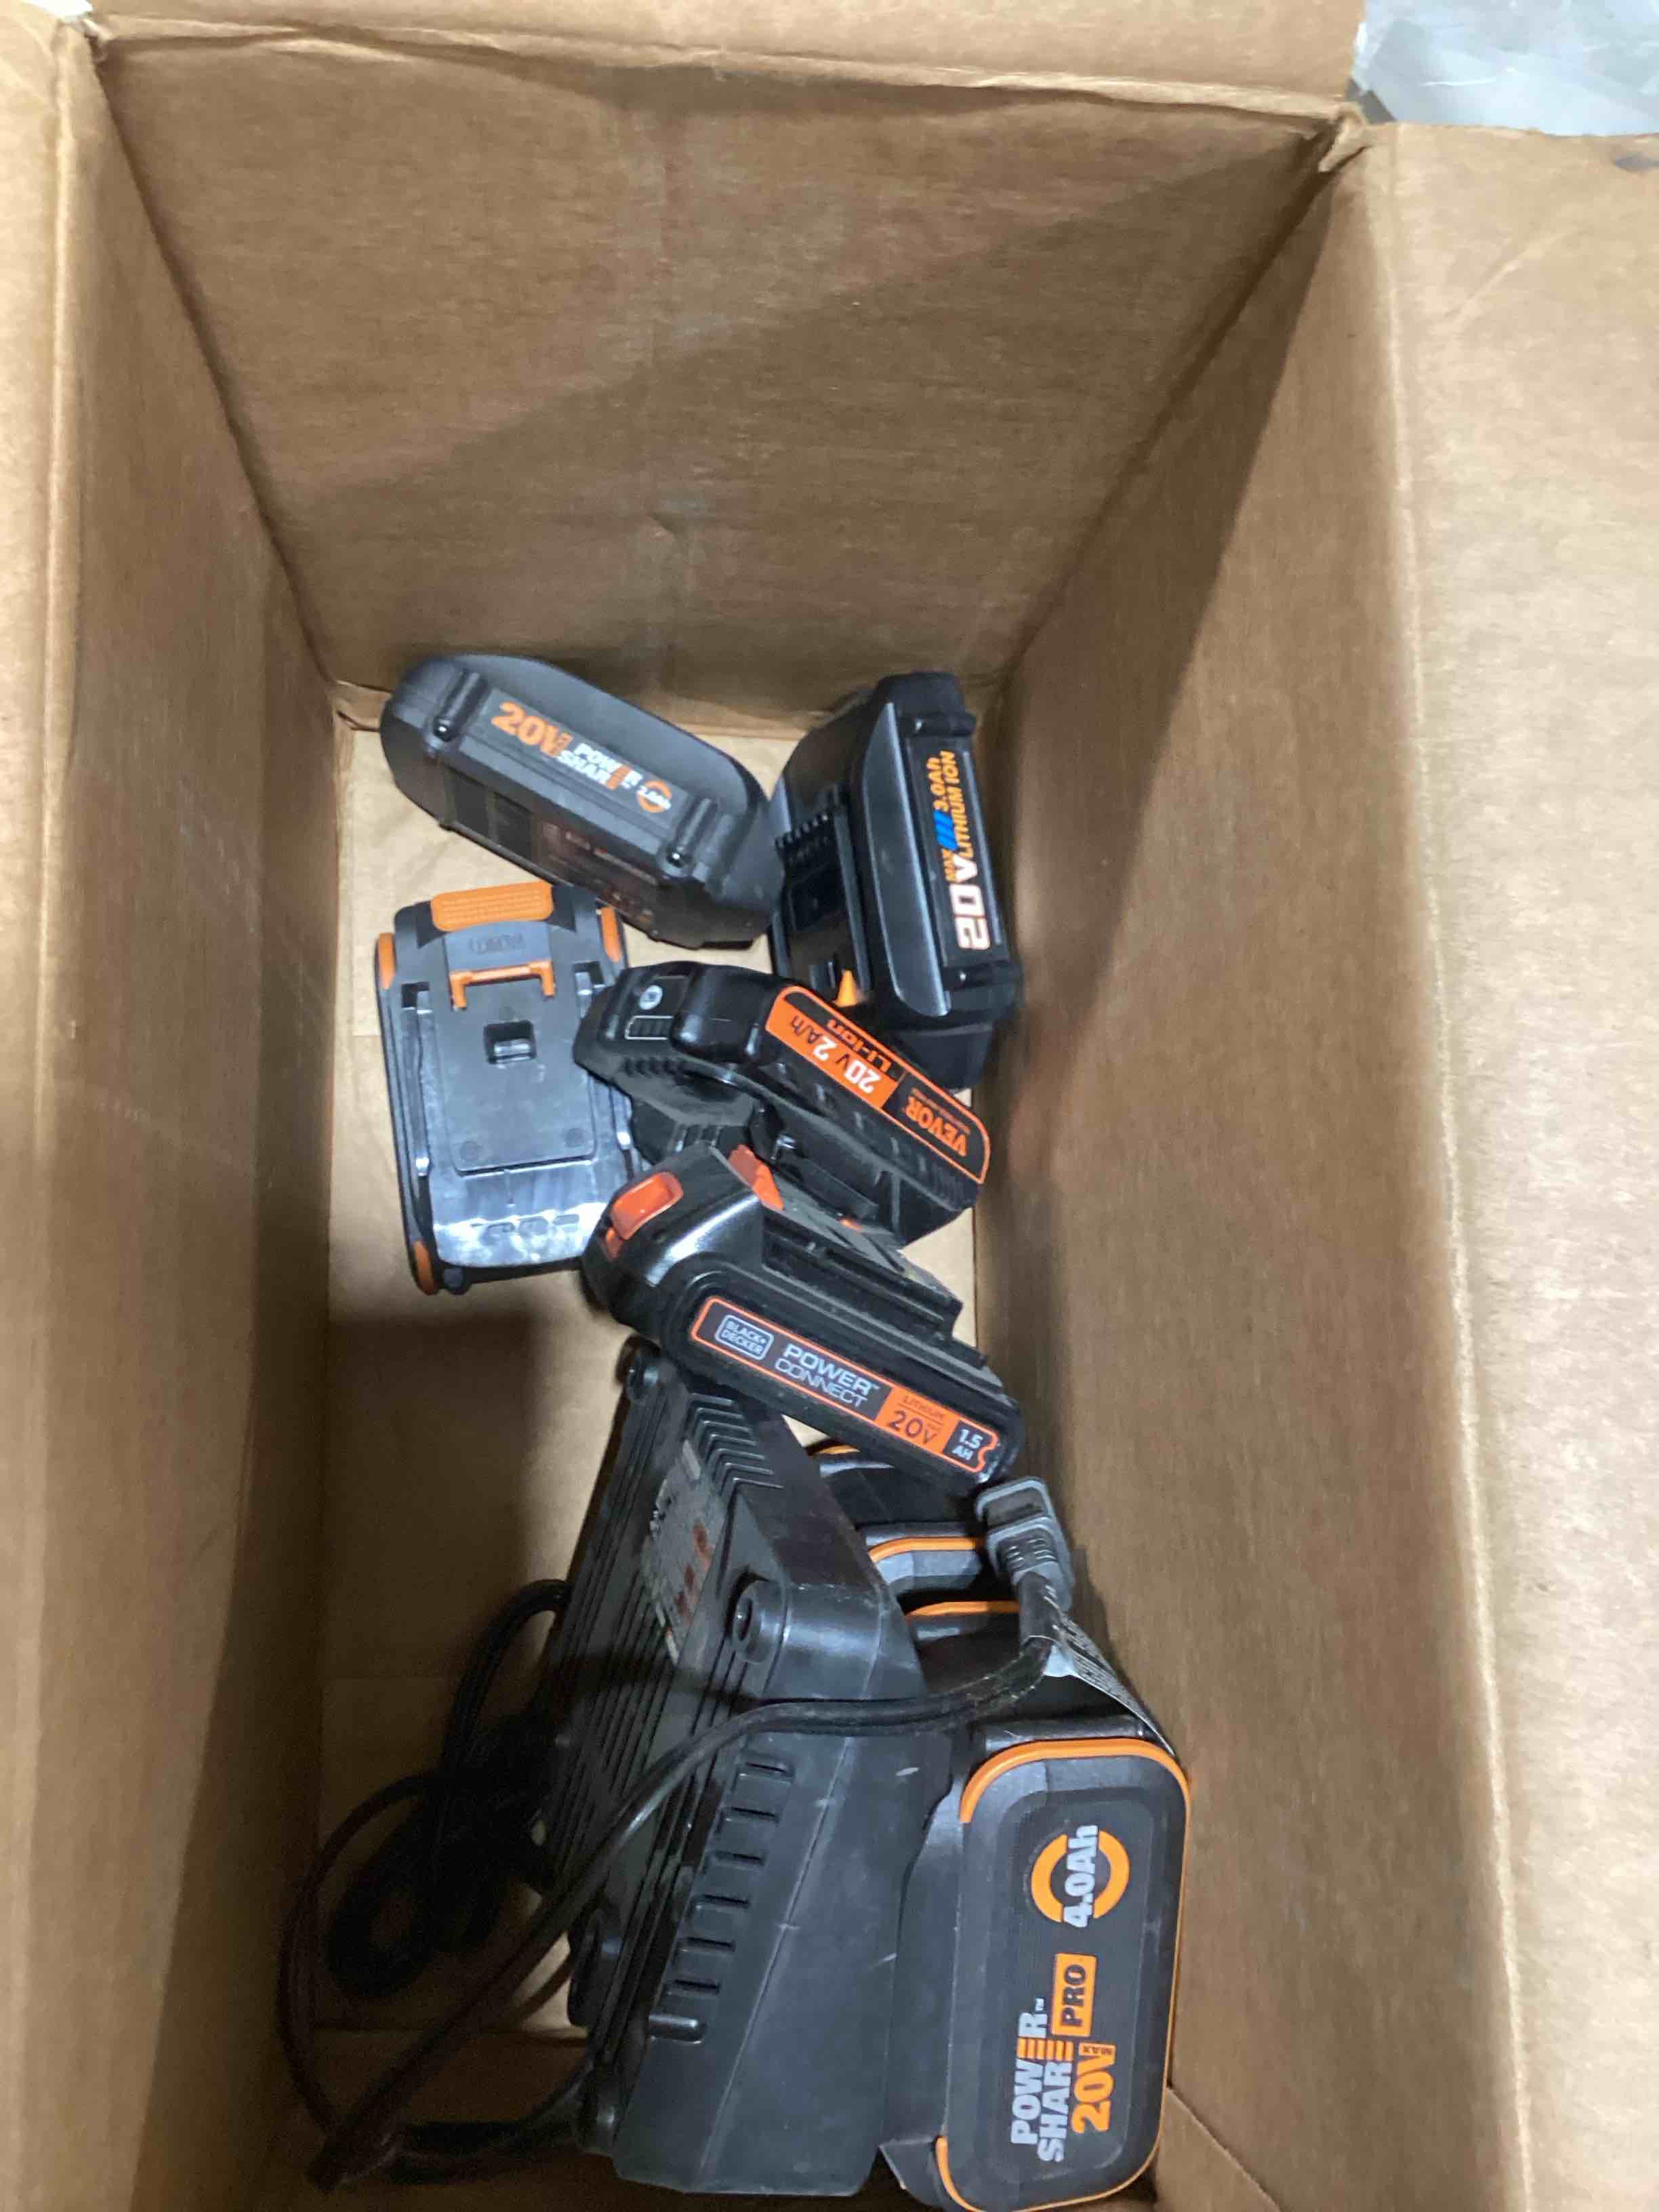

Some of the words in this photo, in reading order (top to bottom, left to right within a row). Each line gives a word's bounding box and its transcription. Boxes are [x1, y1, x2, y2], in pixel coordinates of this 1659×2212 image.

[491, 701, 571, 758] 20V
[926, 757, 949, 813] 3.0Ah
[940, 750, 960, 784] ION
[947, 786, 975, 859] LITHIUM
[949, 853, 991, 950] 20V
[835, 1052, 881, 1095] 20V
[904, 1095, 967, 1158] VEVOR
[720, 1329, 764, 1355] DECKER
[783, 1343, 872, 1396] POWER
[775, 1357, 868, 1408] CONNECT
[888, 1409, 938, 1446] 20V
[951, 1444, 975, 1461] AH
[958, 1428, 984, 1450] 1.5
[1063, 1824, 1099, 1928] 4.0Ah
[1060, 1964, 1086, 2027] PRO
[1010, 2011, 1048, 2145] POWER
[1037, 2039, 1074, 2163] SHARE
[1070, 2043, 1118, 2135] 20V
